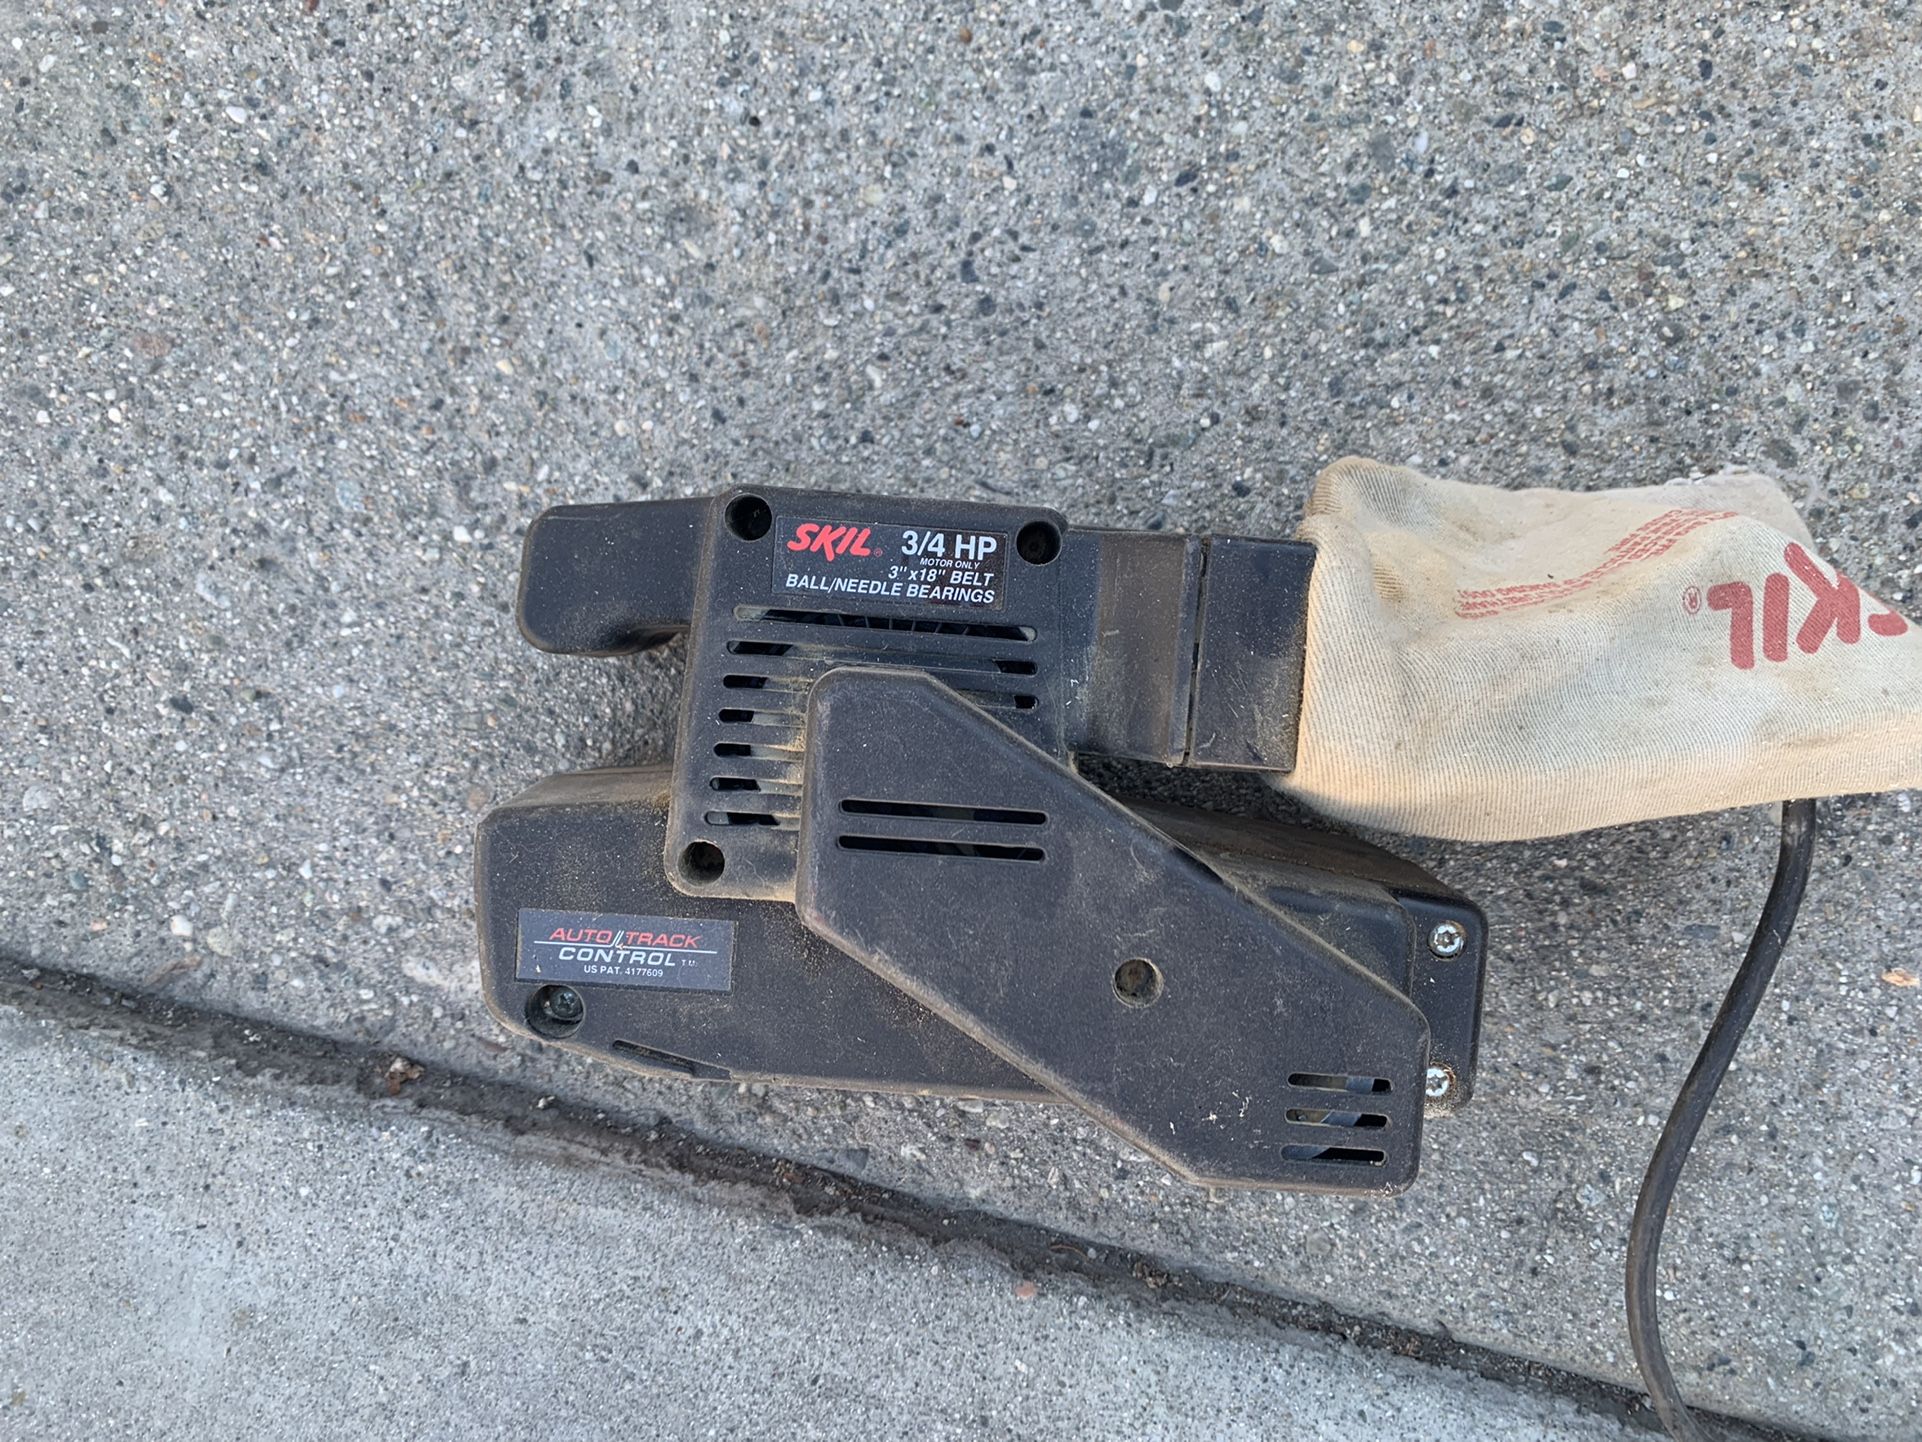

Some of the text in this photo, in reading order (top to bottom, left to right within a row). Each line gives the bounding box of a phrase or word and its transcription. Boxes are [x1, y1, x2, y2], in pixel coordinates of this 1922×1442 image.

[787, 523, 871, 561] SKIL
[901, 530, 997, 560] 3/4 HP
[920, 557, 980, 570] MOTOR ONLY
[785, 573, 995, 604] BALL/NEEDLE BEARINGS
[950, 571, 994, 587] BELT
[1706, 541, 1909, 671] KIL
[550, 927, 702, 948] AUTO TRACK
[558, 947, 676, 966] CONTROL
[584, 965, 664, 978] US PAT. 4177609
